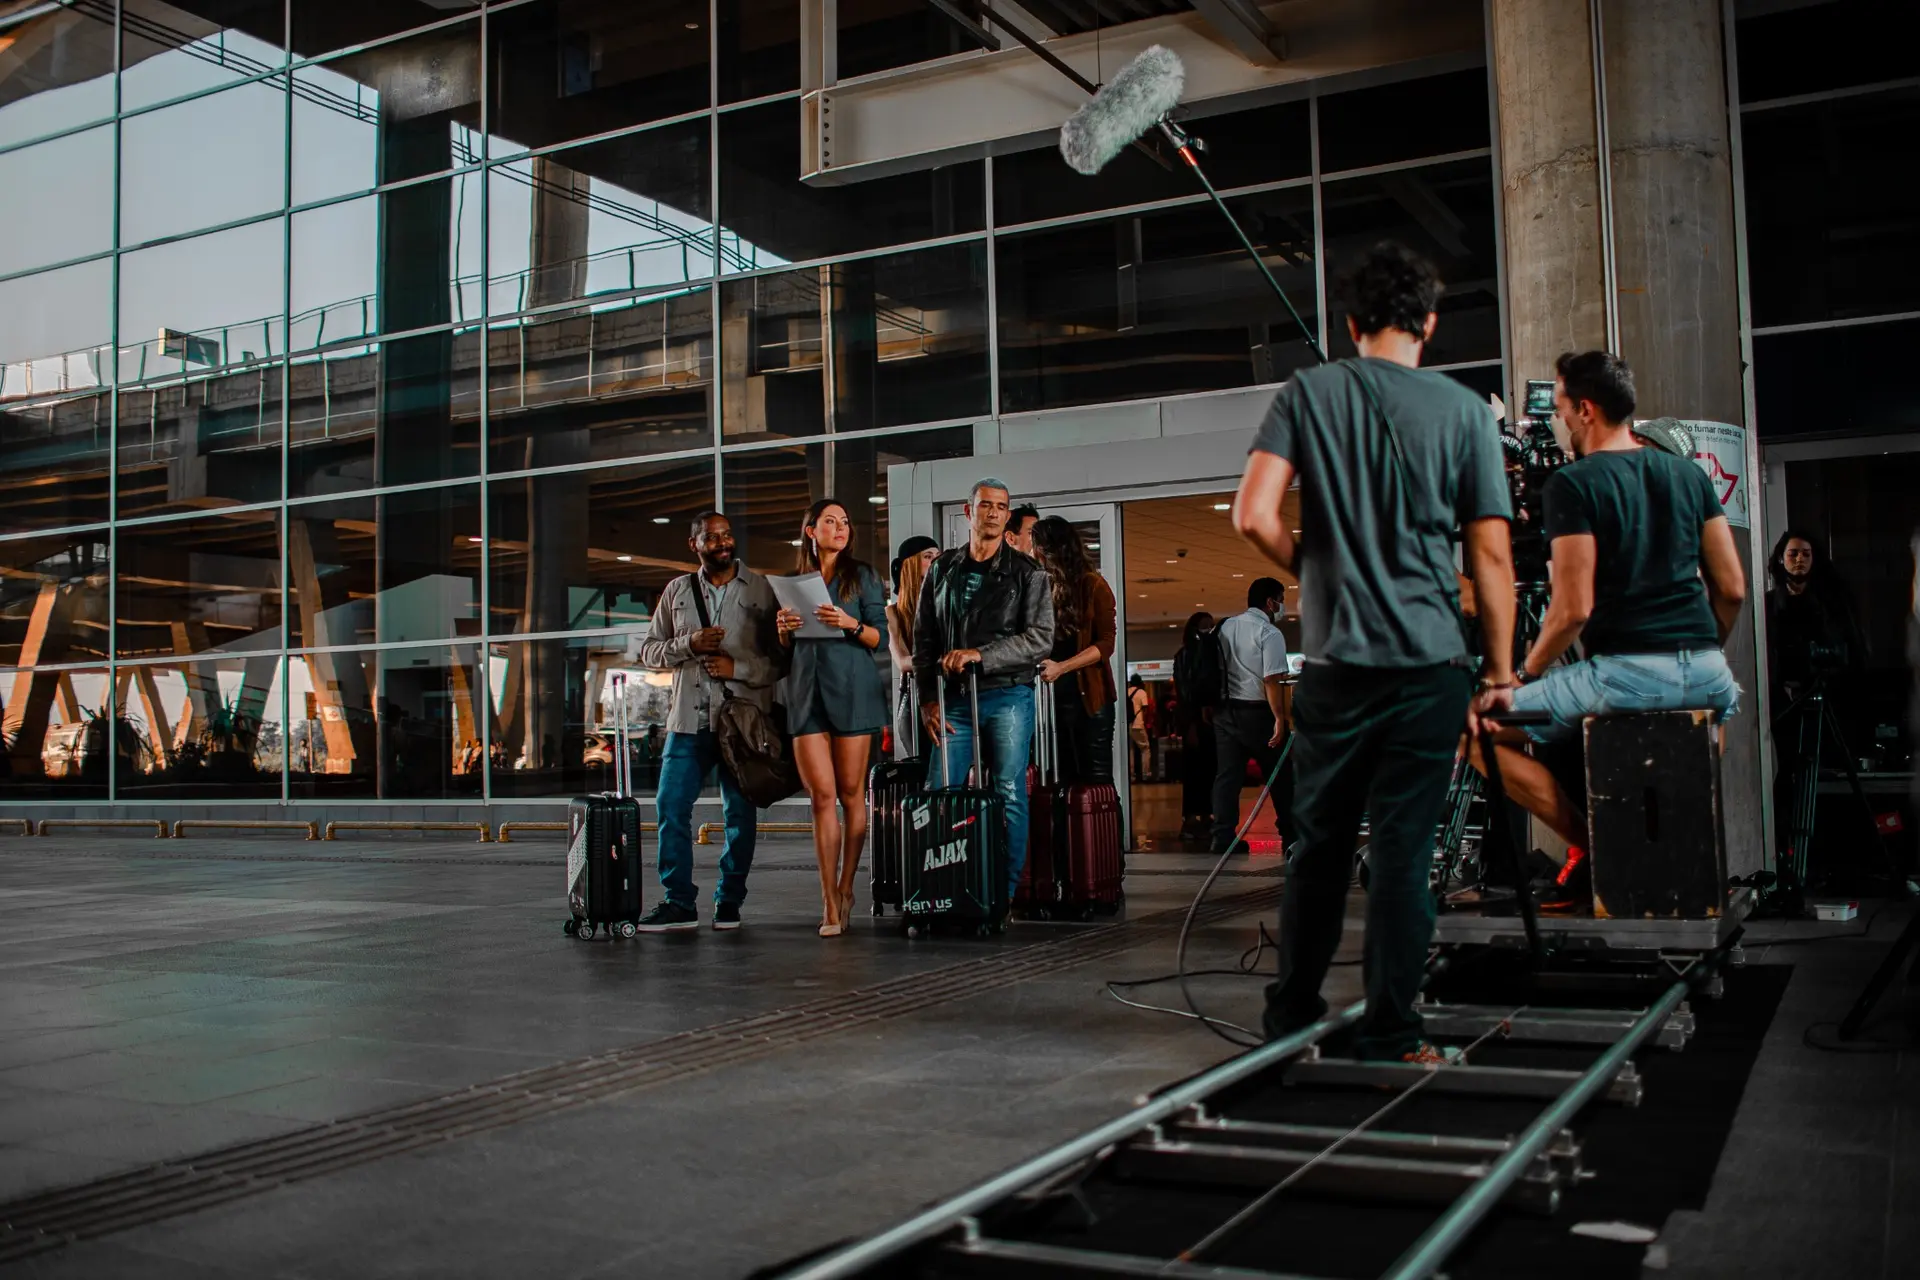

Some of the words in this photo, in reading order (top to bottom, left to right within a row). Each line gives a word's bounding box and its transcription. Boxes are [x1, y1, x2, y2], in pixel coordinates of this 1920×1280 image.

[1694, 424, 1716, 434] fumar
[912, 803, 930, 830] 5
[923, 839, 968, 871] AJAX
